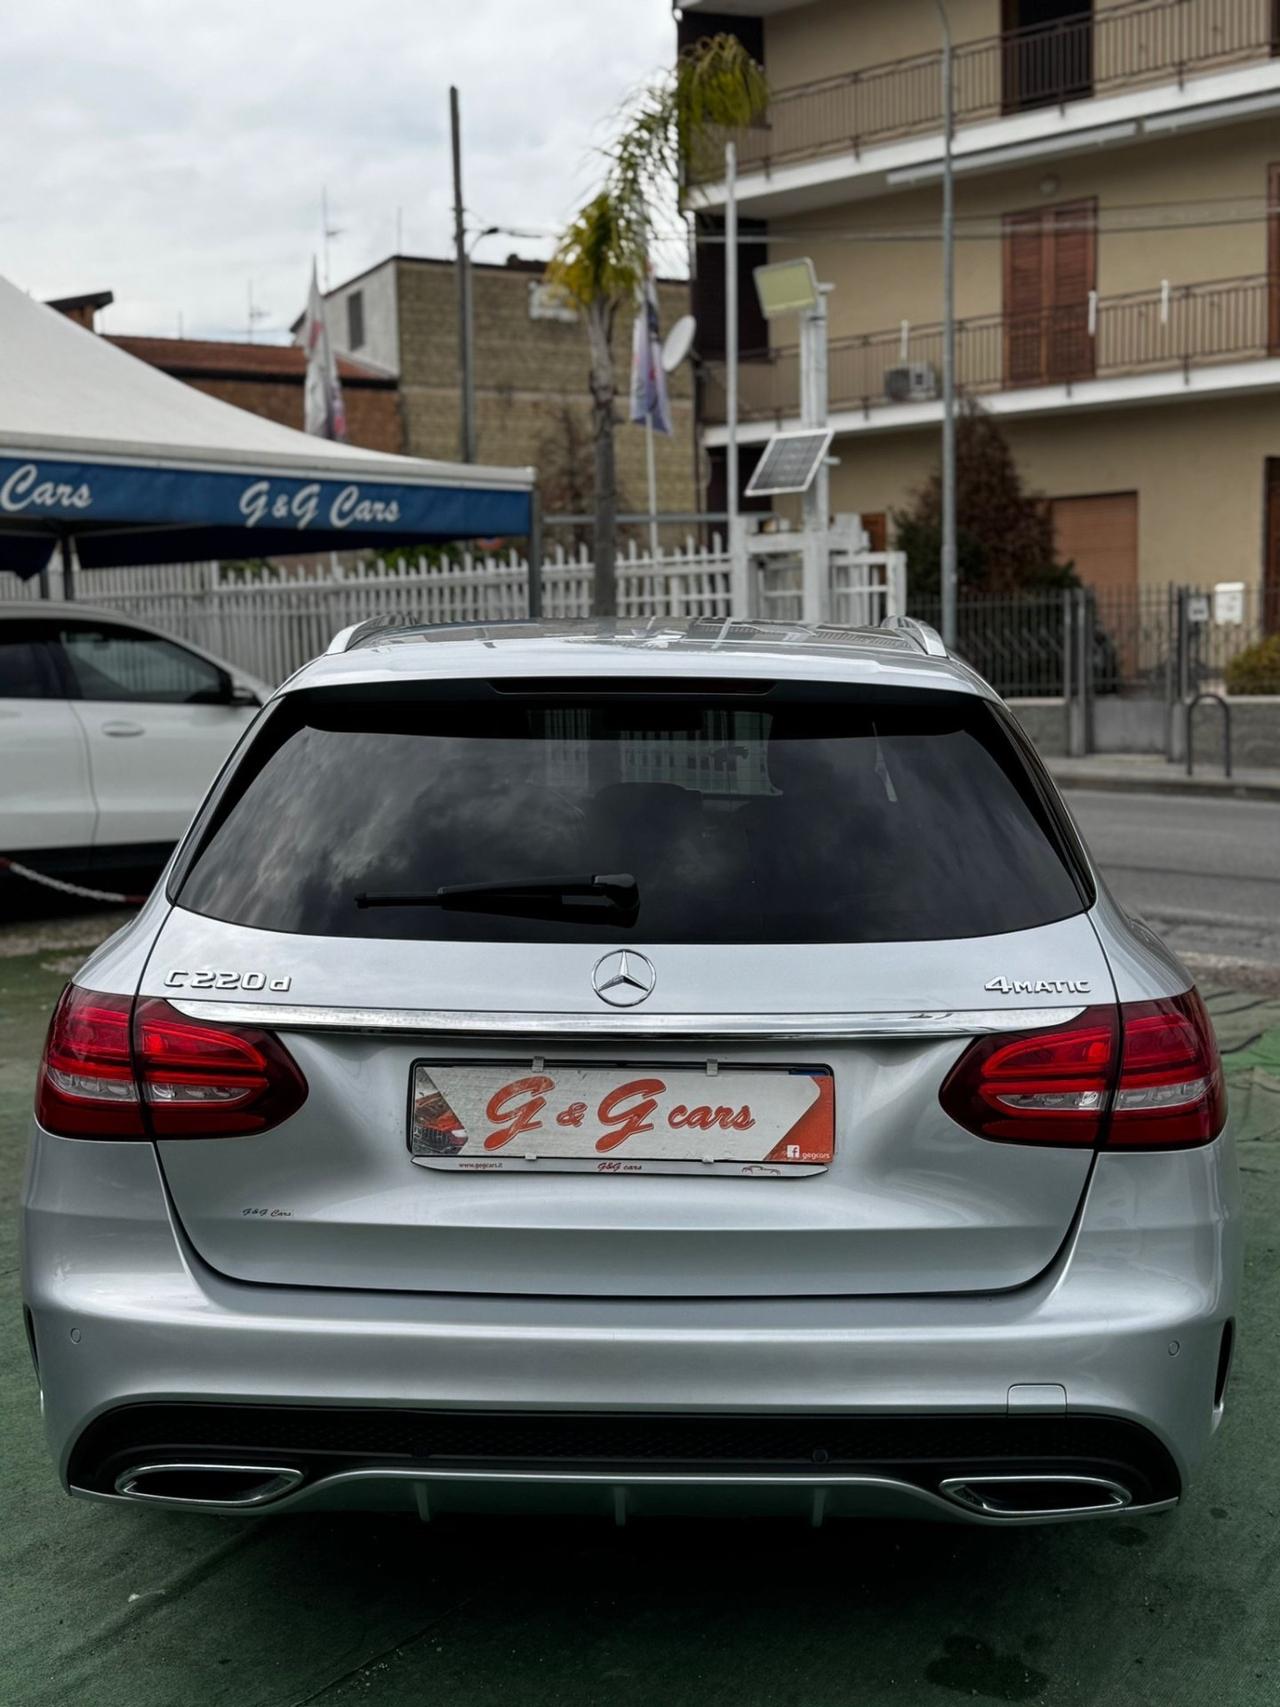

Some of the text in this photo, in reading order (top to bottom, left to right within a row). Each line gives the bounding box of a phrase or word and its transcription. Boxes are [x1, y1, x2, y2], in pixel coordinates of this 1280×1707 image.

[0, 464, 93, 512] Cars
[329, 486, 401, 528] Cars
[984, 975, 1091, 995] 4MATIC
[667, 1103, 757, 1132] cars
[458, 1162, 504, 1170] www.gegcars.it
